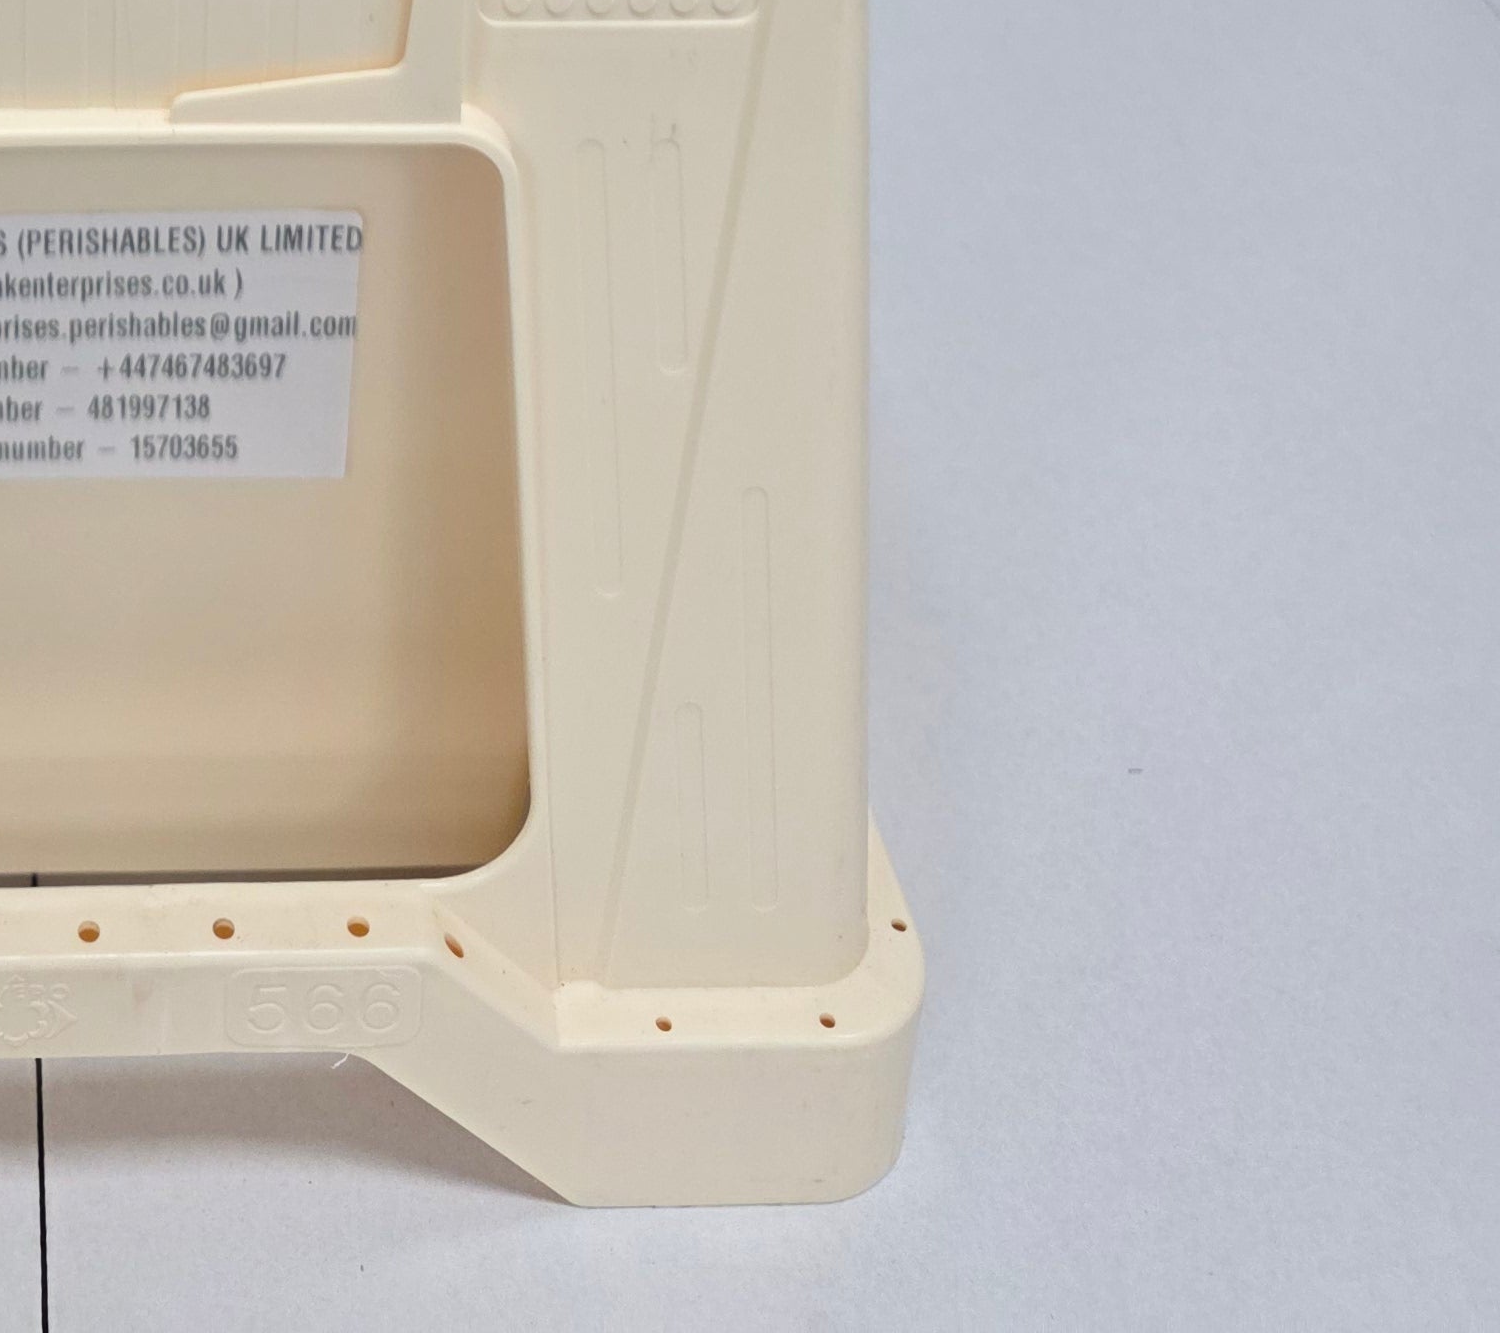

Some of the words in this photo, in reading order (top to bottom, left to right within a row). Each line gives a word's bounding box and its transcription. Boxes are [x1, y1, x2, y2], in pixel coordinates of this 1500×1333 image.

[17, 225, 207, 261] (PERISHABLES)
[216, 225, 249, 255] UK
[260, 224, 365, 254] LIMITED
[87, 394, 211, 421] 481997138
[131, 434, 239, 461] 15703655
[246, 983, 401, 1033] 566
